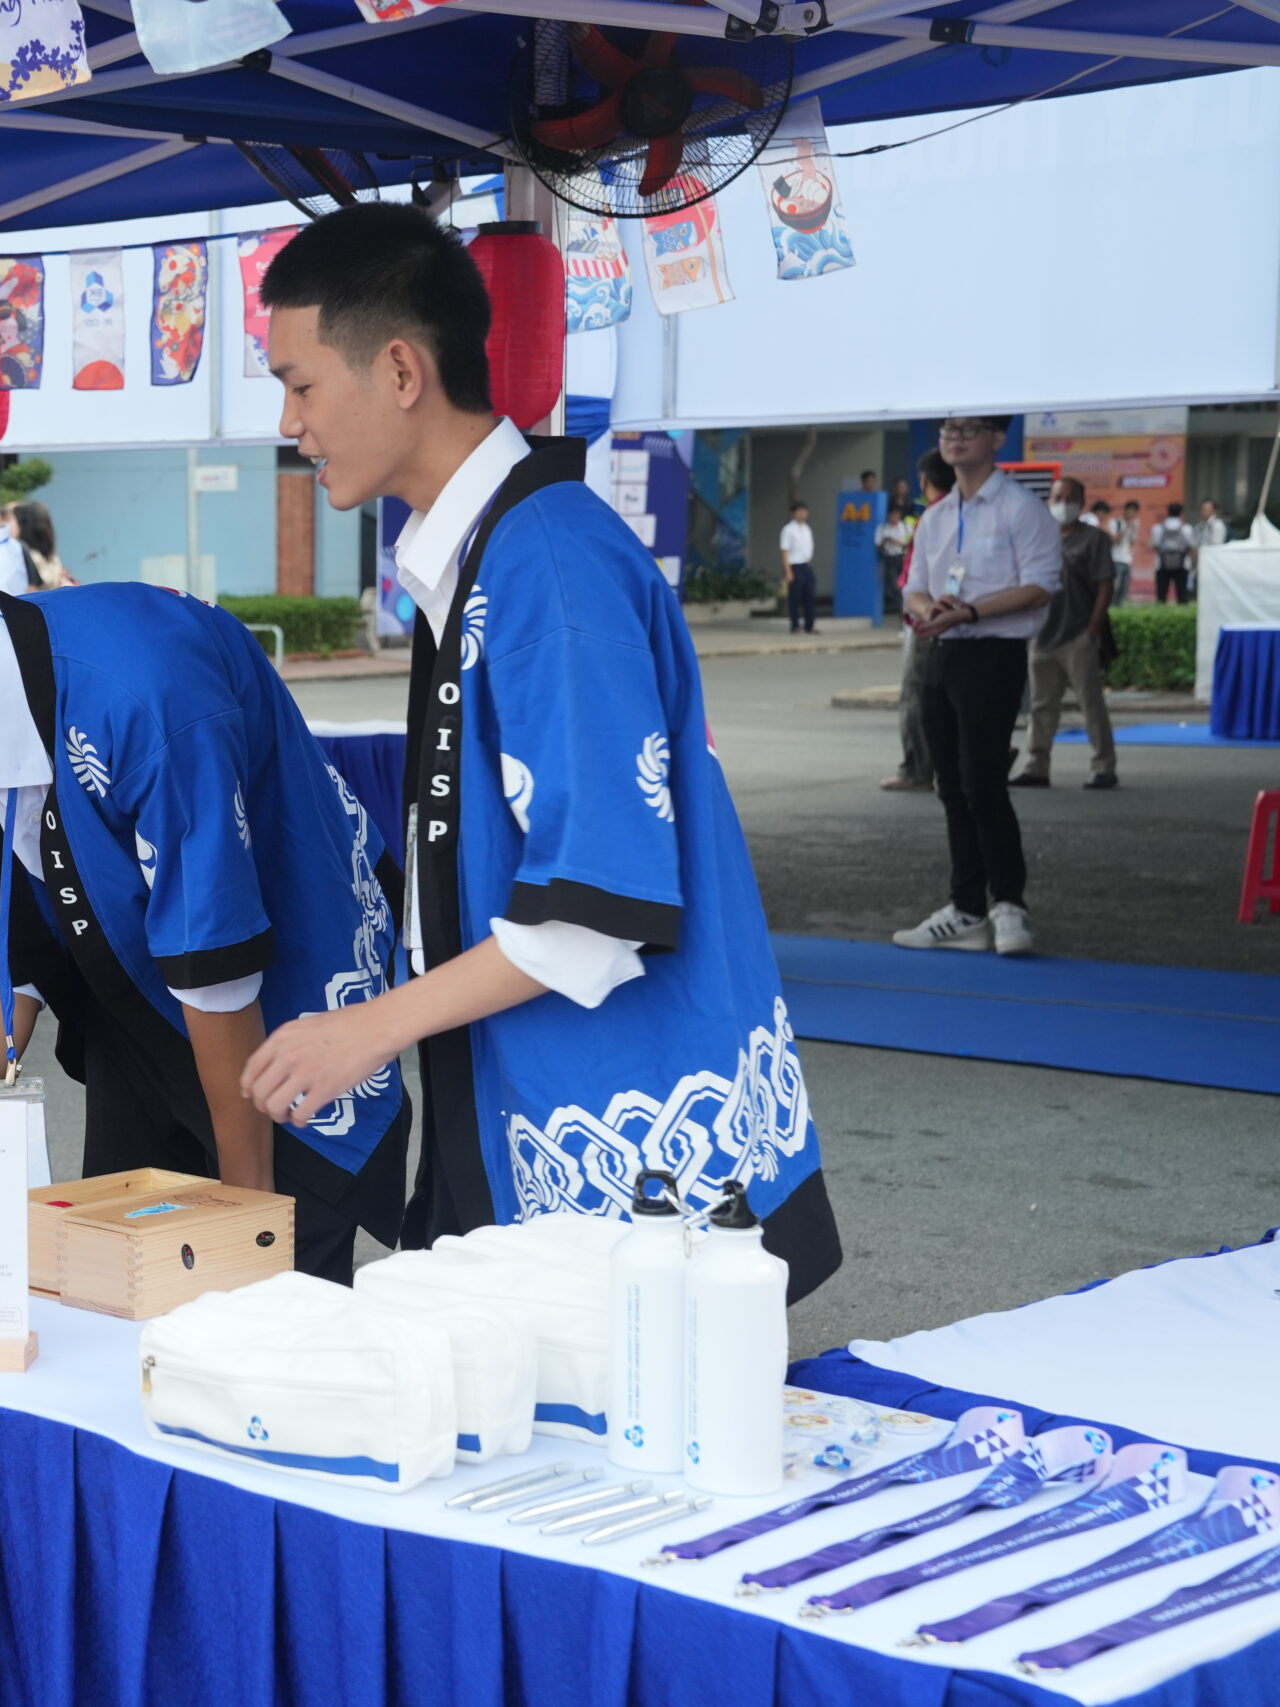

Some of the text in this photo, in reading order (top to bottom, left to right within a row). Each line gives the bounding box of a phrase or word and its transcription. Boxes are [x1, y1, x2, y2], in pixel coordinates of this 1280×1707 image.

[842, 503, 871, 521] A4
[428, 682, 461, 842] OISP
[46, 811, 89, 936] OISP
